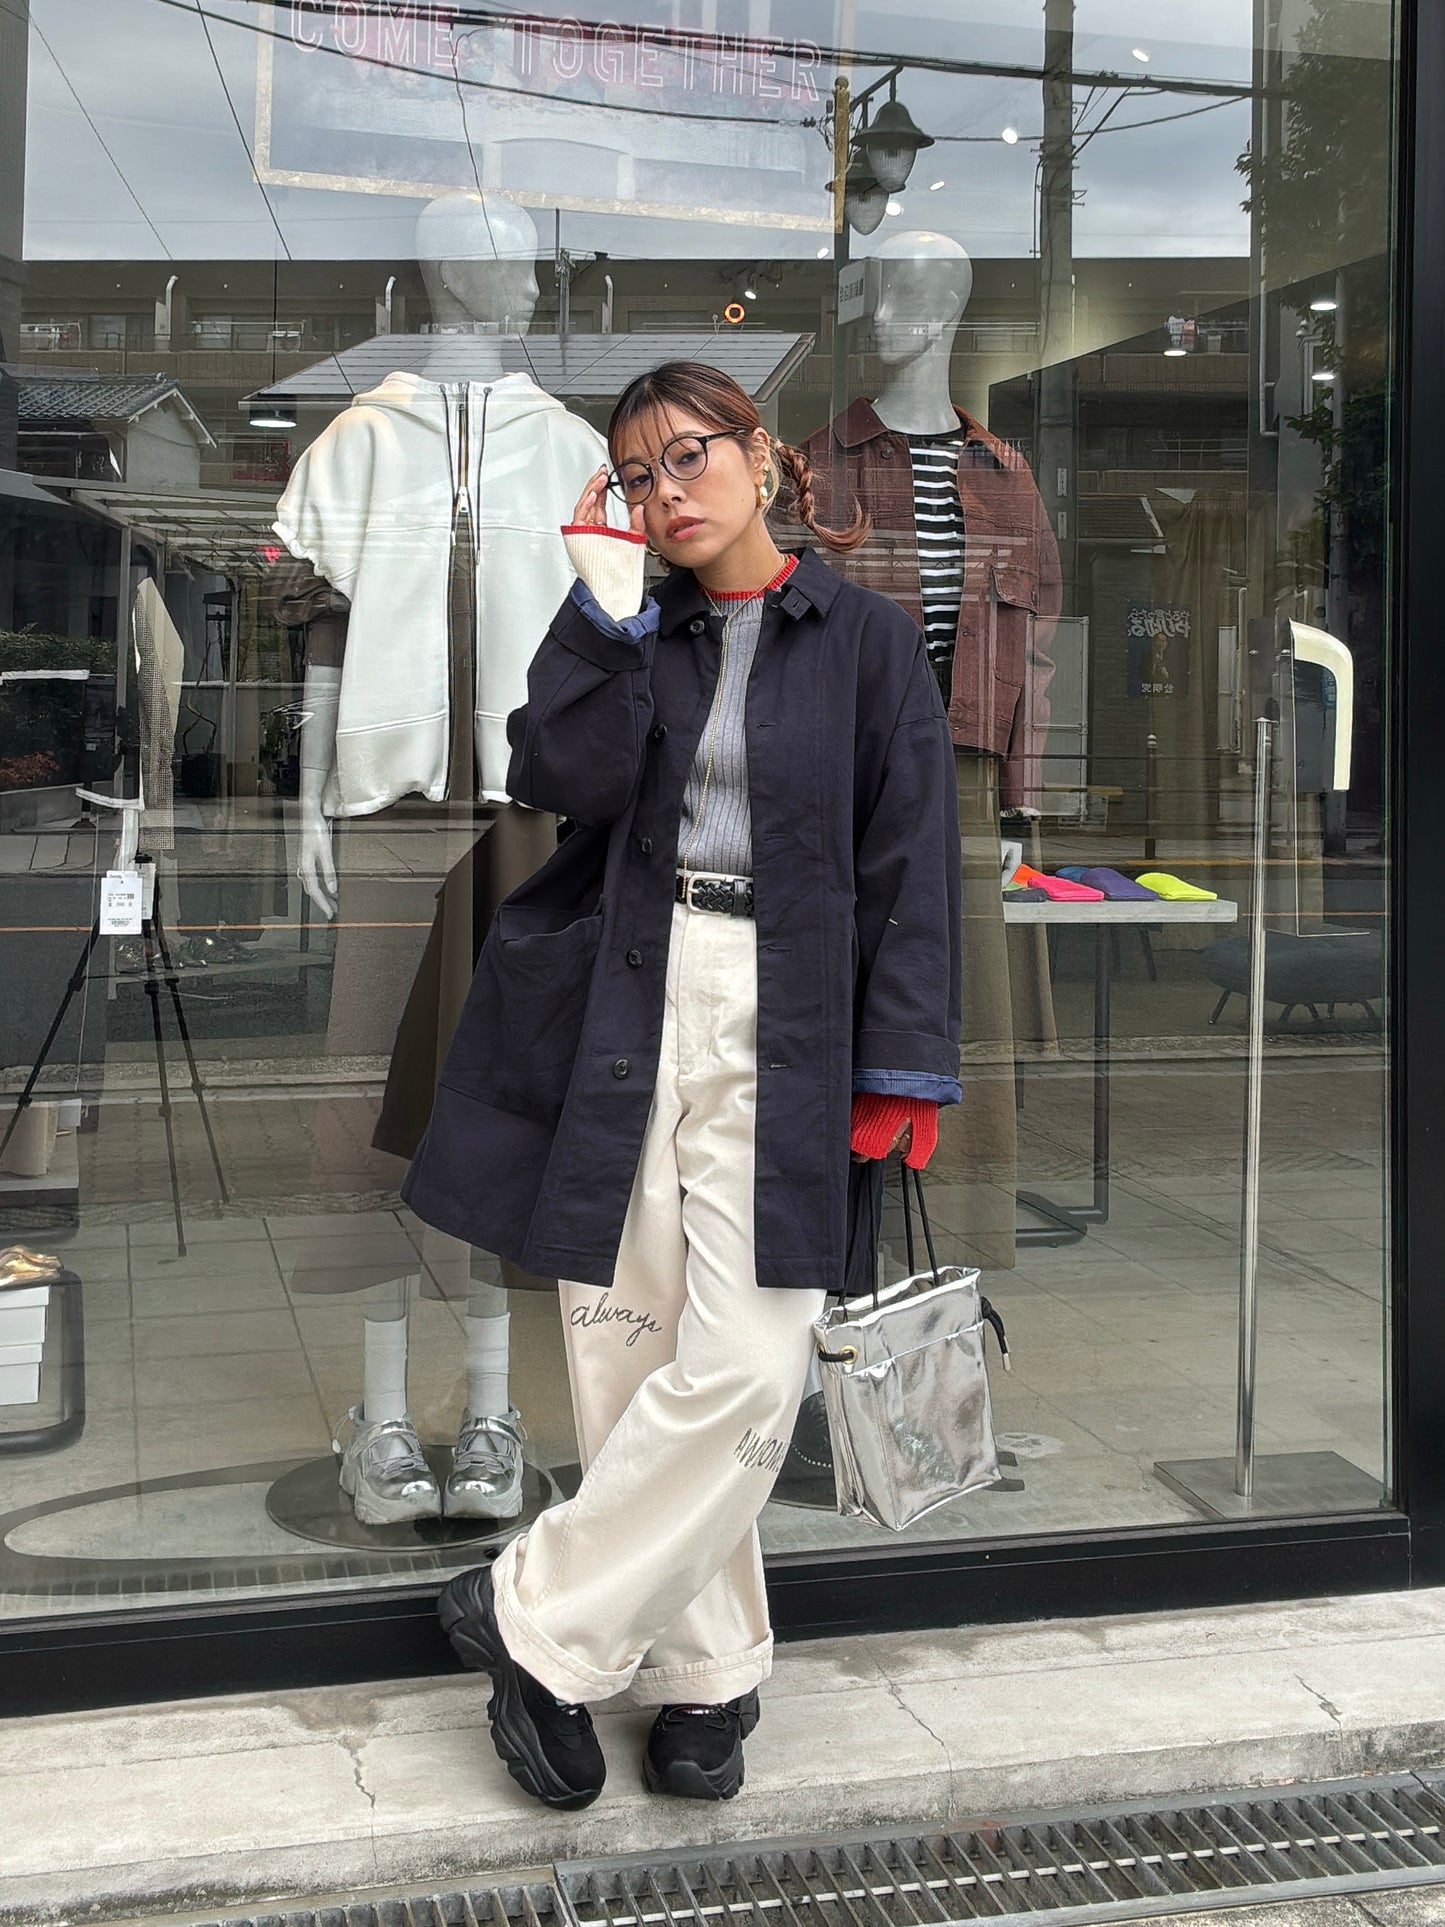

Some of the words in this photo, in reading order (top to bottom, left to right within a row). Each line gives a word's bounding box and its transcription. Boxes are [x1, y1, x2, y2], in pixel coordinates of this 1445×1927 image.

[290, 0, 460, 67] COME
[513, 16, 822, 102] TOGETHER
[571, 1292, 662, 1347] always
